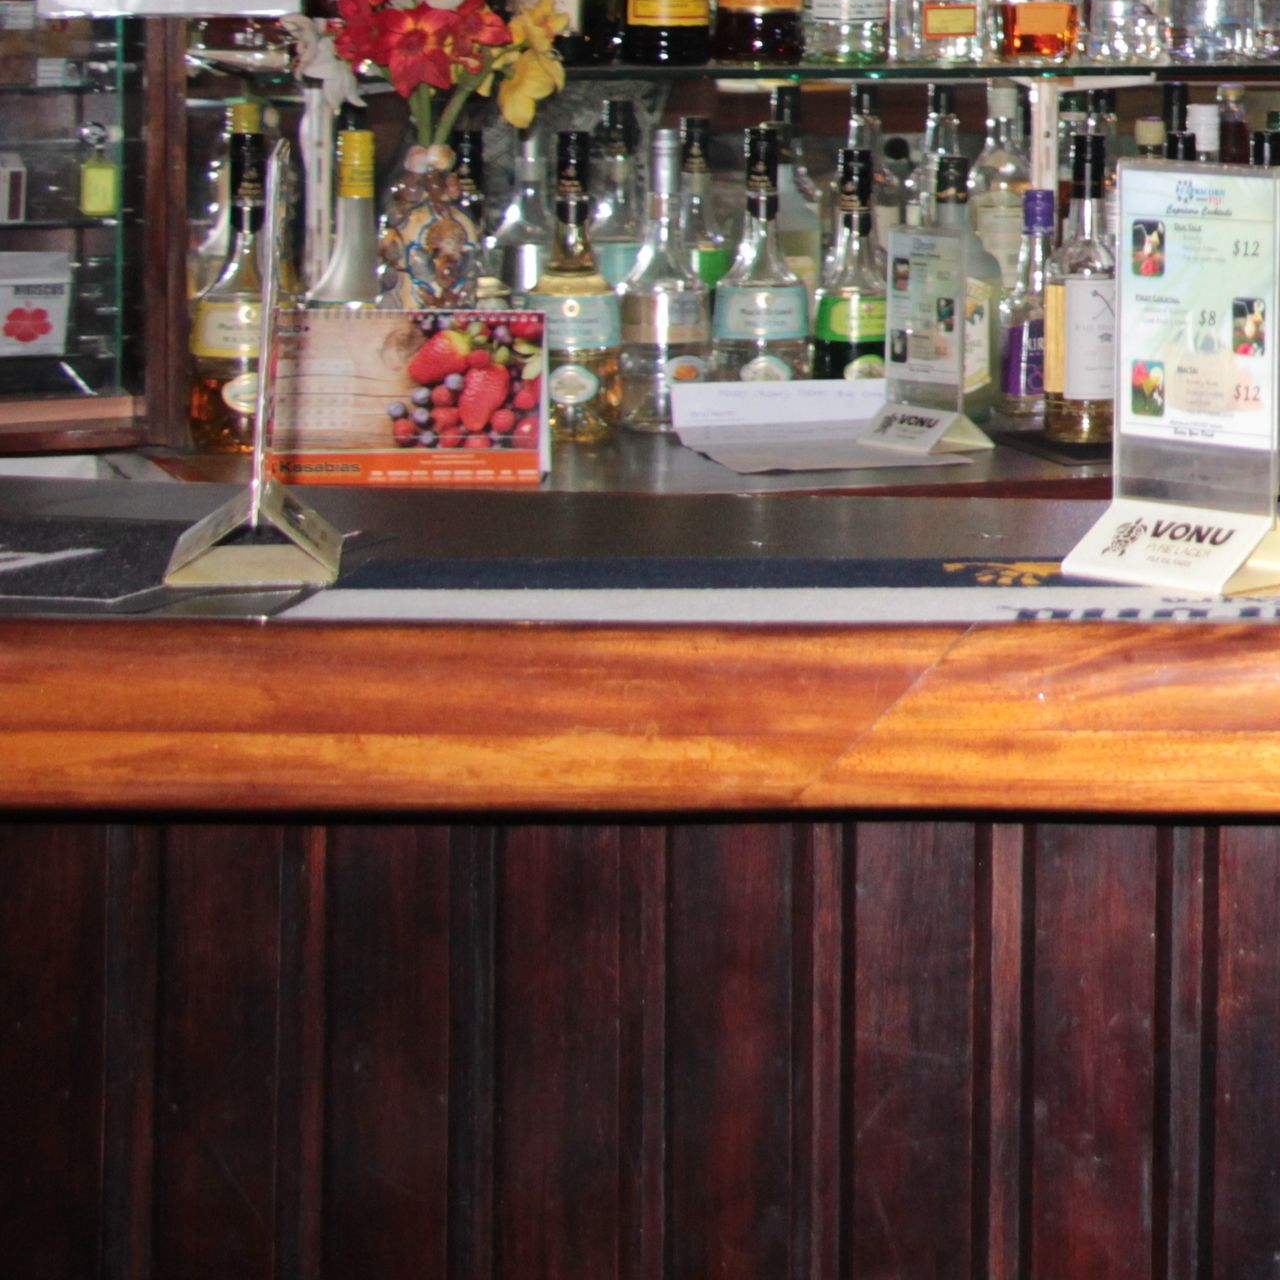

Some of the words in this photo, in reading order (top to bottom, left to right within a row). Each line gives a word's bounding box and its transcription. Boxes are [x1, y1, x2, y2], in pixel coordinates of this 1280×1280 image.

[1232, 239, 1260, 258] $12
[1199, 310, 1217, 326] $8
[1234, 384, 1260, 402] $12
[1150, 519, 1236, 546] VONU
